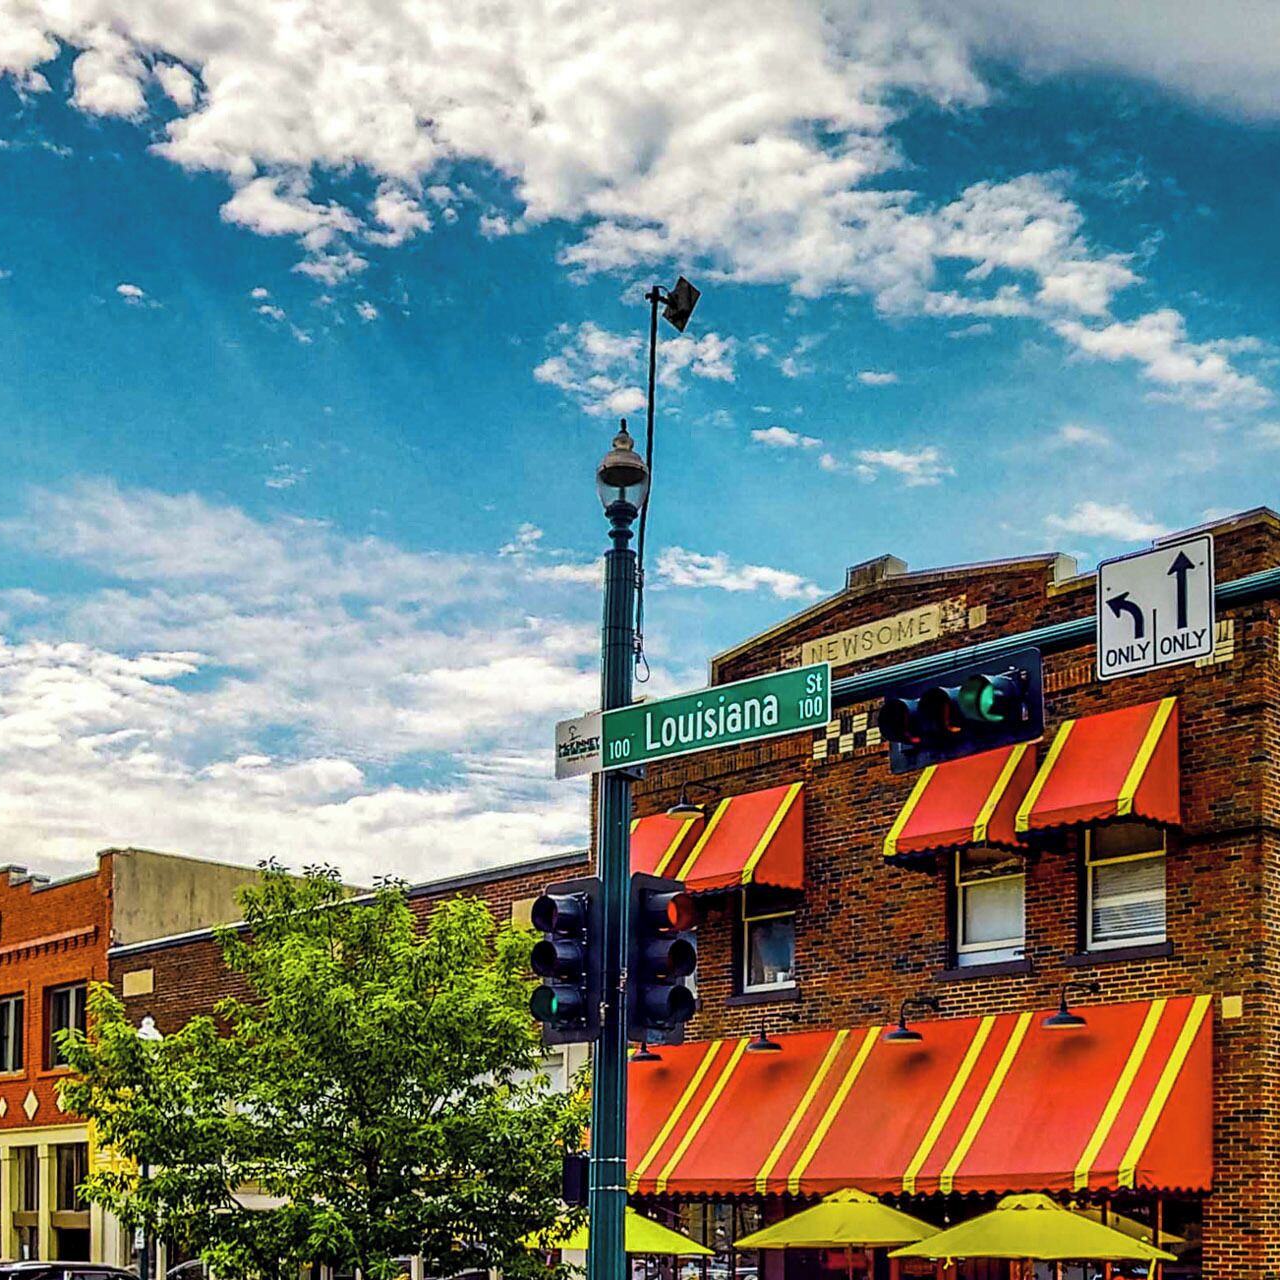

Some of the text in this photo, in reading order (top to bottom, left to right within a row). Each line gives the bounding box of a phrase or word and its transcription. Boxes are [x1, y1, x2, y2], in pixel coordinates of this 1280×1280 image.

[811, 611, 932, 665] NEWSOME
[1106, 628, 1207, 667] ONLY ONLY
[609, 738, 630, 760] 100
[645, 694, 779, 750] Louisiana
[806, 673, 823, 694] St
[798, 697, 823, 720] 100
